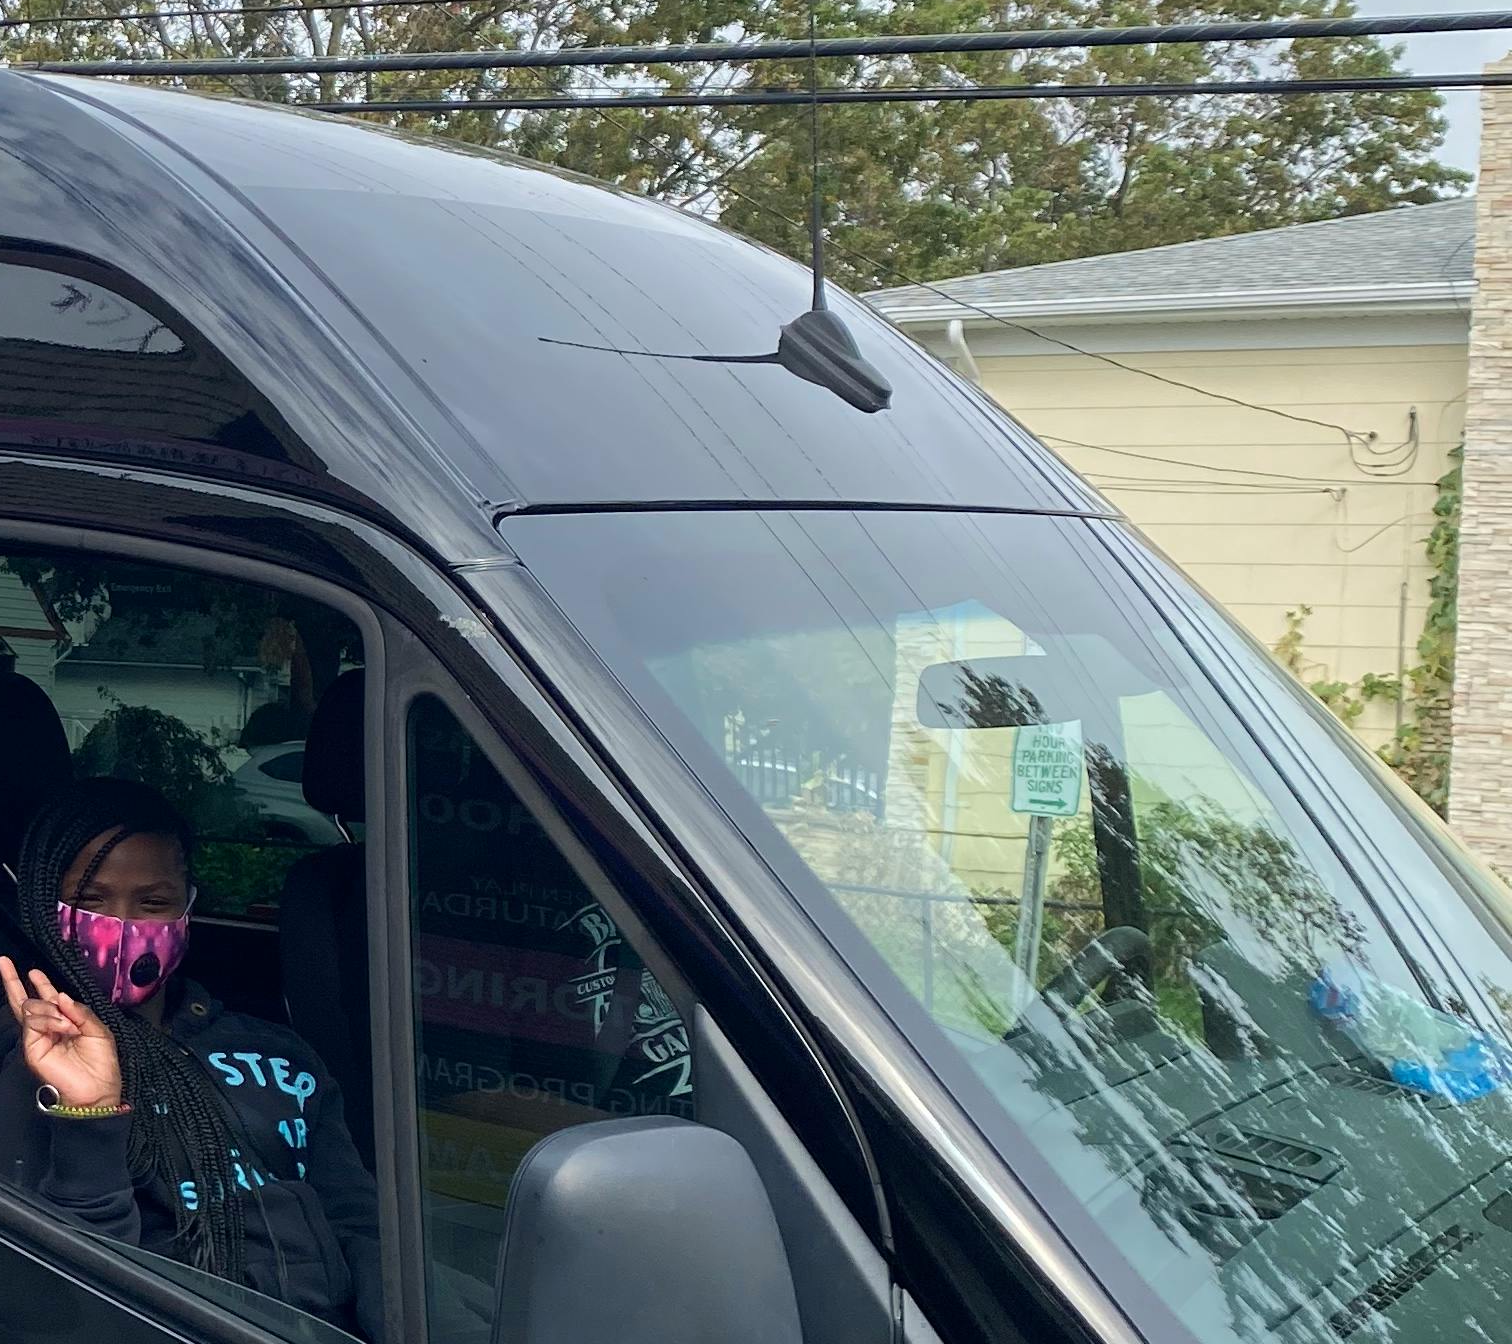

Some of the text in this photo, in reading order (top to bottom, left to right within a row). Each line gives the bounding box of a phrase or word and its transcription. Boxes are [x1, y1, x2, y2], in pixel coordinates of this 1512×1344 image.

[1032, 735, 1066, 749] HOUR
[1020, 750, 1076, 764] PARKING
[1016, 764, 1078, 779] BETWEEN
[1027, 779, 1064, 794] SIGNS
